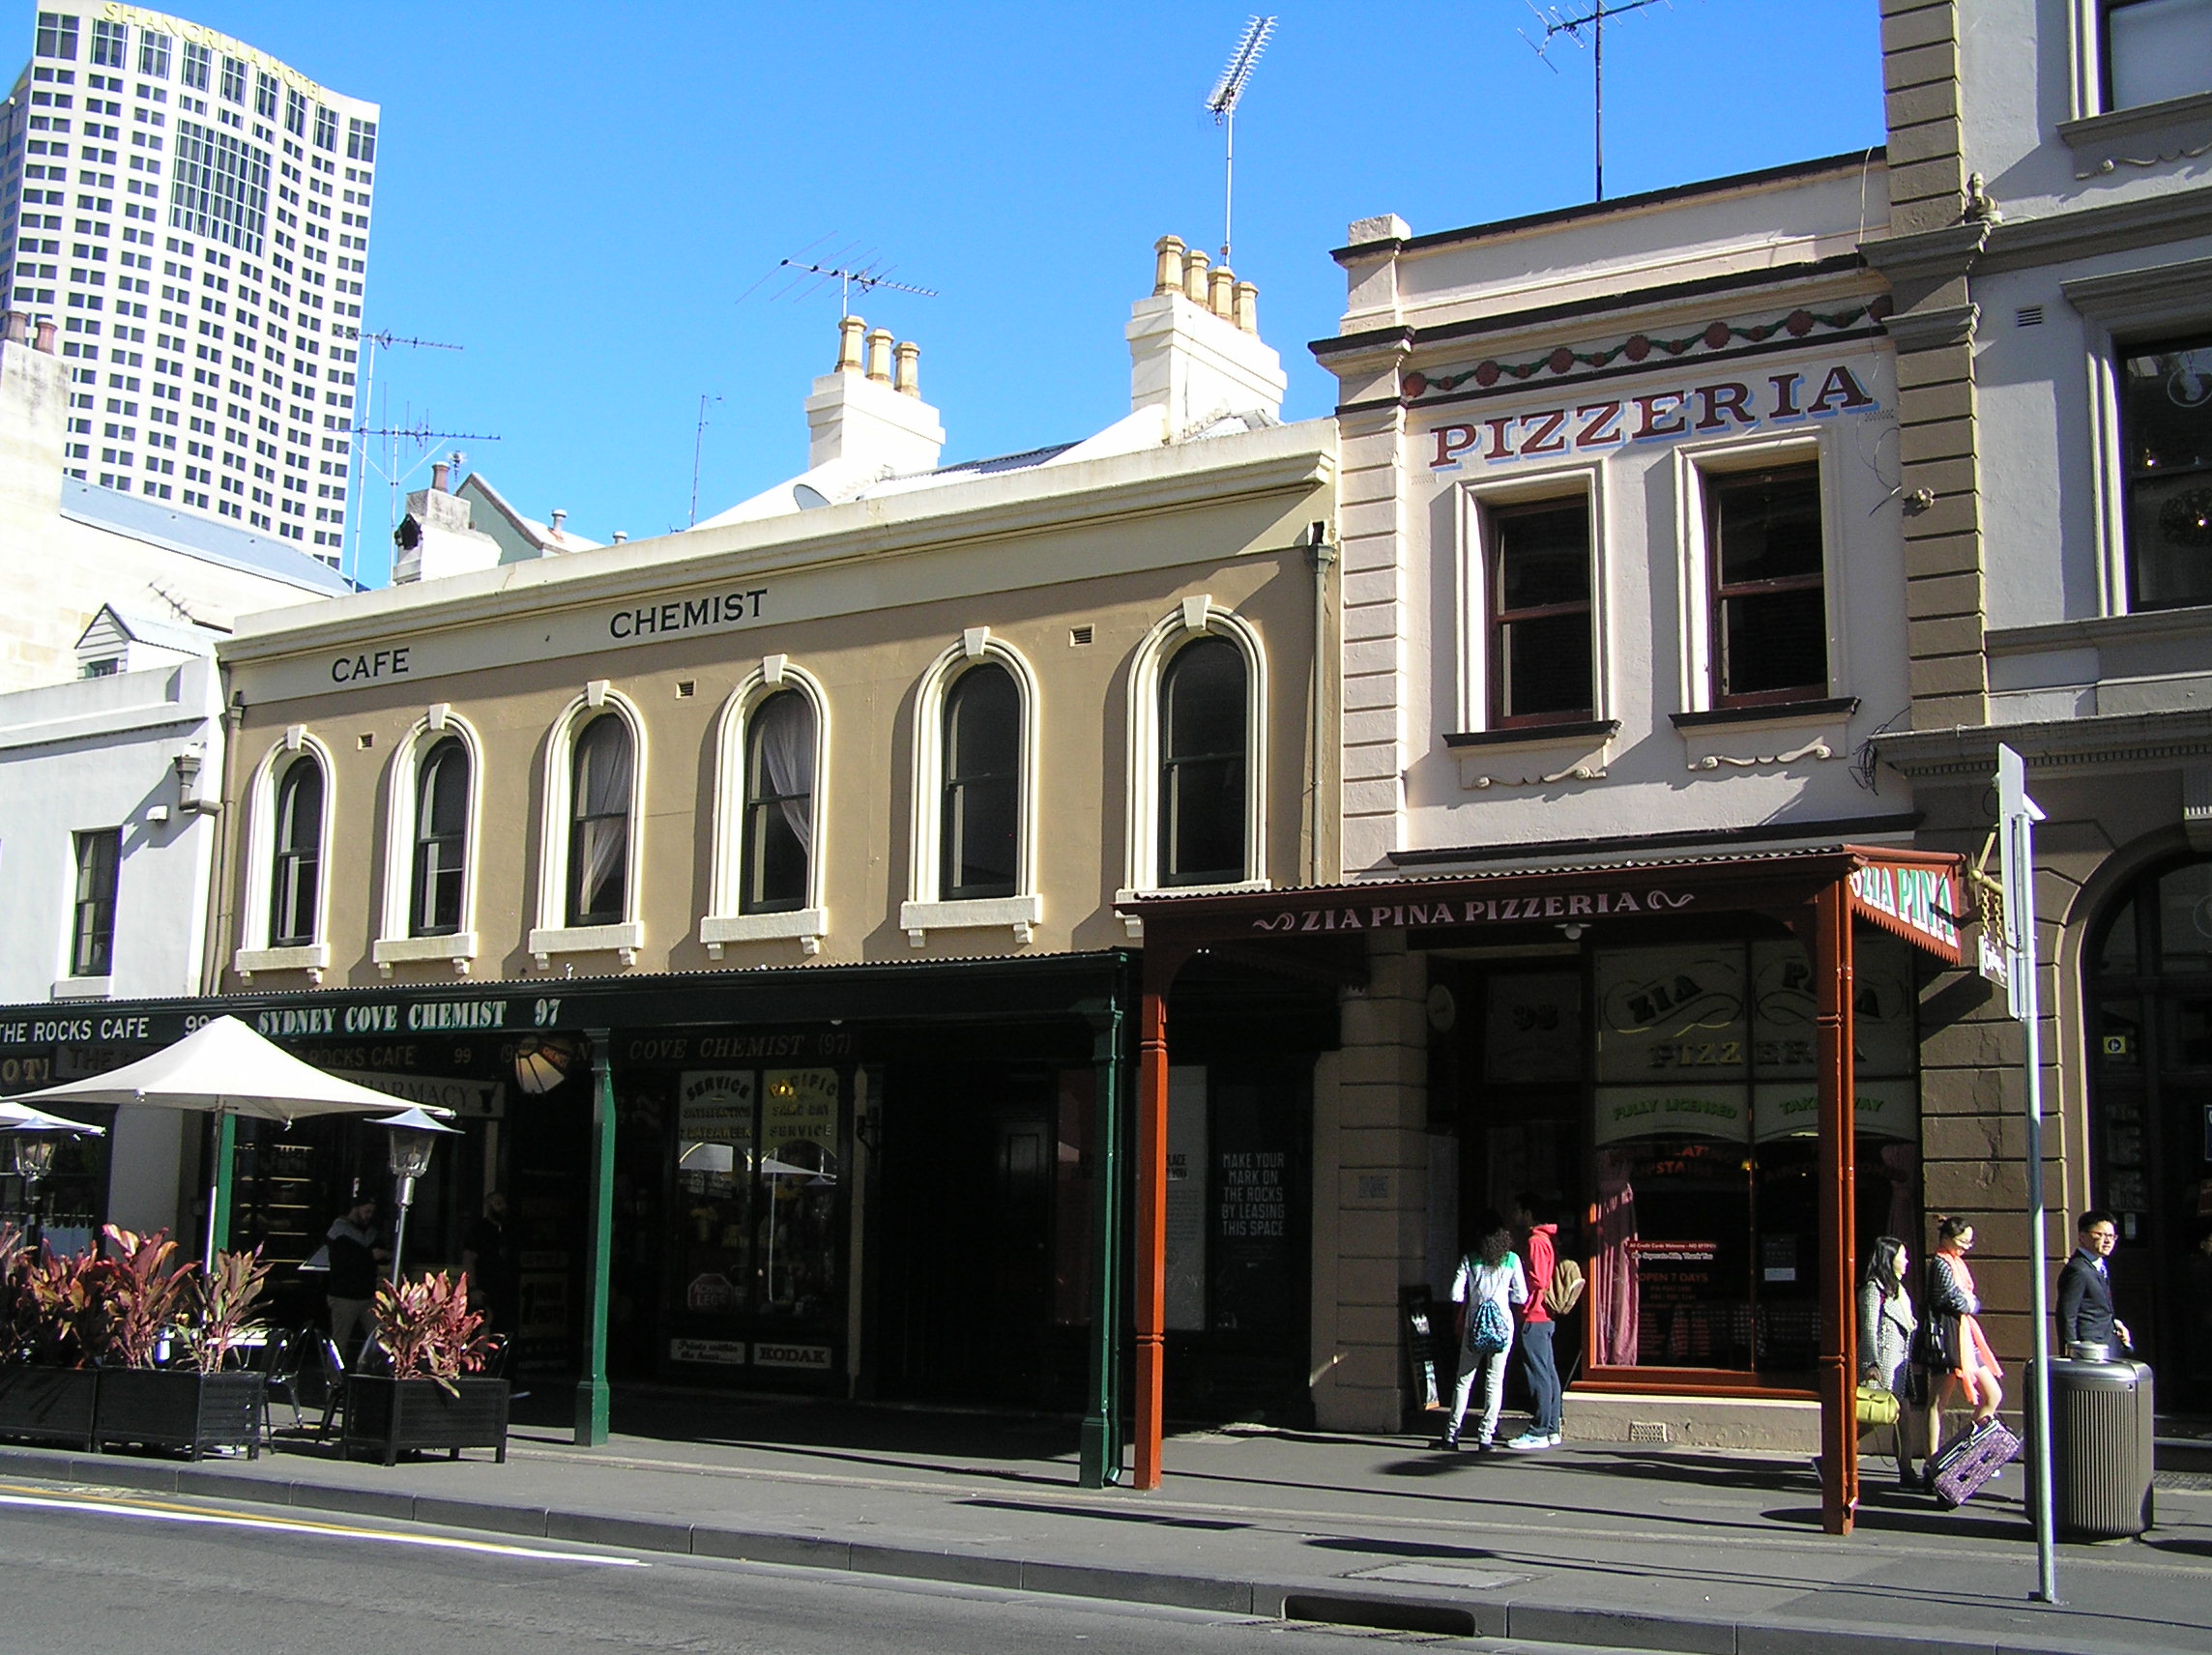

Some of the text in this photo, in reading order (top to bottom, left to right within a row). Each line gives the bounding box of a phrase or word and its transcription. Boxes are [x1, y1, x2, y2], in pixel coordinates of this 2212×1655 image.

[103, 3, 326, 105] SHANGRI-LA HOTEL
[1429, 364, 1879, 471] PIZZERIA
[609, 589, 768, 638] CHEMIST
[332, 647, 410, 682] CAFE
[1301, 891, 1640, 931] ZIA PINA PIZZERIA
[1862, 865, 1958, 948] ZIA PINA
[1627, 973, 1703, 1025] ZIA
[33, 1019, 92, 1042] ROCKS
[100, 1017, 150, 1040] CAFE
[185, 1015, 210, 1036] 99
[257, 998, 561, 1035] SYDNEY COVE CHEMIST 97
[371, 1045, 417, 1065] CAFE
[453, 1047, 472, 1064] 99
[629, 1032, 851, 1060] COVE CHEMIST (97)
[686, 1074, 751, 1100] SERVICE
[1614, 1098, 1738, 1119] FULLY LICENSED
[770, 1124, 832, 1138] SERVICE
[1223, 1152, 1284, 1169] MAKE YOUR
[1229, 1170, 1278, 1185] MARK ON
[1223, 1186, 1283, 1203] THE ROCKS
[1221, 1204, 1284, 1219] BY LEASING
[1222, 1221, 1284, 1236] THIS SPACE
[1639, 1273, 1668, 1282] OPEN
[1679, 1273, 1708, 1282] DAYS
[759, 1347, 826, 1363] KODAK
